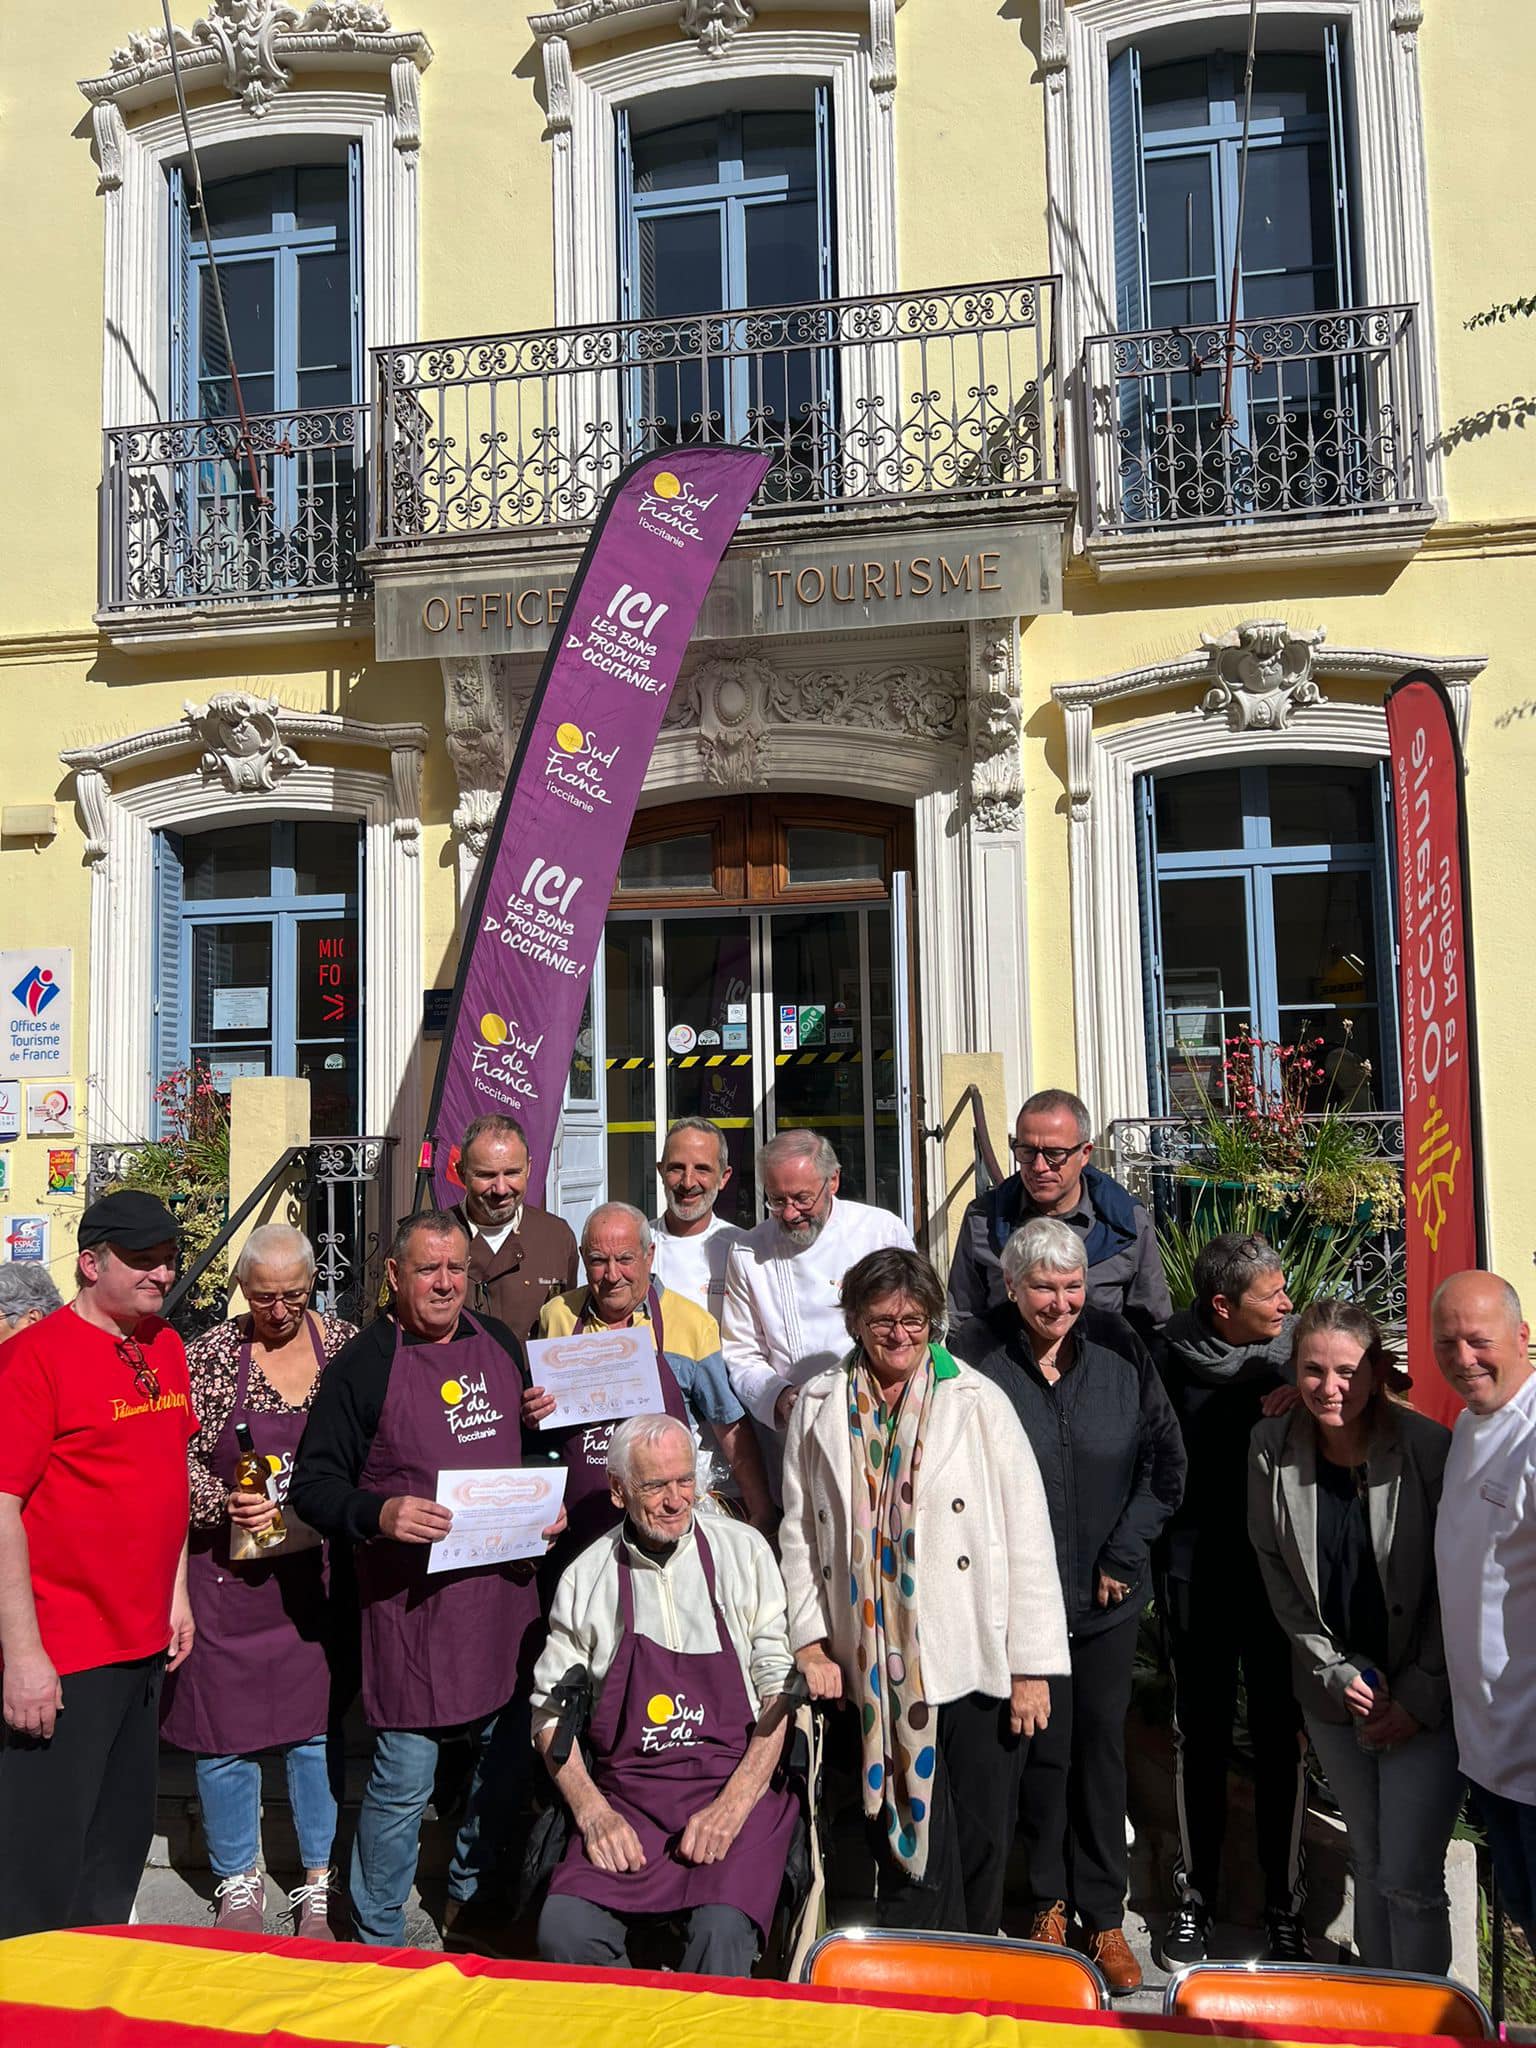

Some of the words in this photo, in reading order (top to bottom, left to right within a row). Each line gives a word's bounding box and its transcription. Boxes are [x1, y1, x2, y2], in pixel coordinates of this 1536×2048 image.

[671, 482, 718, 511] Sud
[638, 491, 703, 540] France
[672, 503, 697, 521] de
[639, 517, 685, 548] l'occitanie
[423, 587, 568, 632] OFFICE
[768, 552, 1002, 607] TOURISME
[606, 584, 669, 638] ICI
[587, 632, 651, 670] PRODUITS
[591, 615, 618, 637] LES
[618, 631, 658, 657] BONS
[573, 731, 620, 768] Sud
[545, 747, 612, 804] France
[577, 760, 602, 781] de
[546, 780, 594, 813] l'occitanie
[521, 858, 583, 915] ICI
[507, 894, 534, 916] LES
[535, 909, 574, 935] BONS
[504, 911, 569, 951] PRODUITS
[10, 1020, 47, 1032] Offices
[50, 1022, 60, 1031] de
[11, 1034, 60, 1047] Tourisme
[498, 1021, 544, 1060] Sud
[10, 1052, 20, 1062] de
[23, 1049, 60, 1060] France
[472, 1041, 538, 1099] France
[502, 1051, 528, 1075] de
[475, 1077, 522, 1110] l'occitanie
[15, 1240, 40, 1249] ESPACE
[457, 1372, 487, 1398] Sud
[467, 1395, 490, 1412] de
[444, 1404, 503, 1434] France
[604, 1423, 615, 1436] d
[457, 1427, 496, 1443] l'occitanie
[583, 1427, 609, 1453] Fra
[586, 1455, 608, 1465] l'occit
[665, 1694, 704, 1725] Sud
[671, 1721, 698, 1740] de
